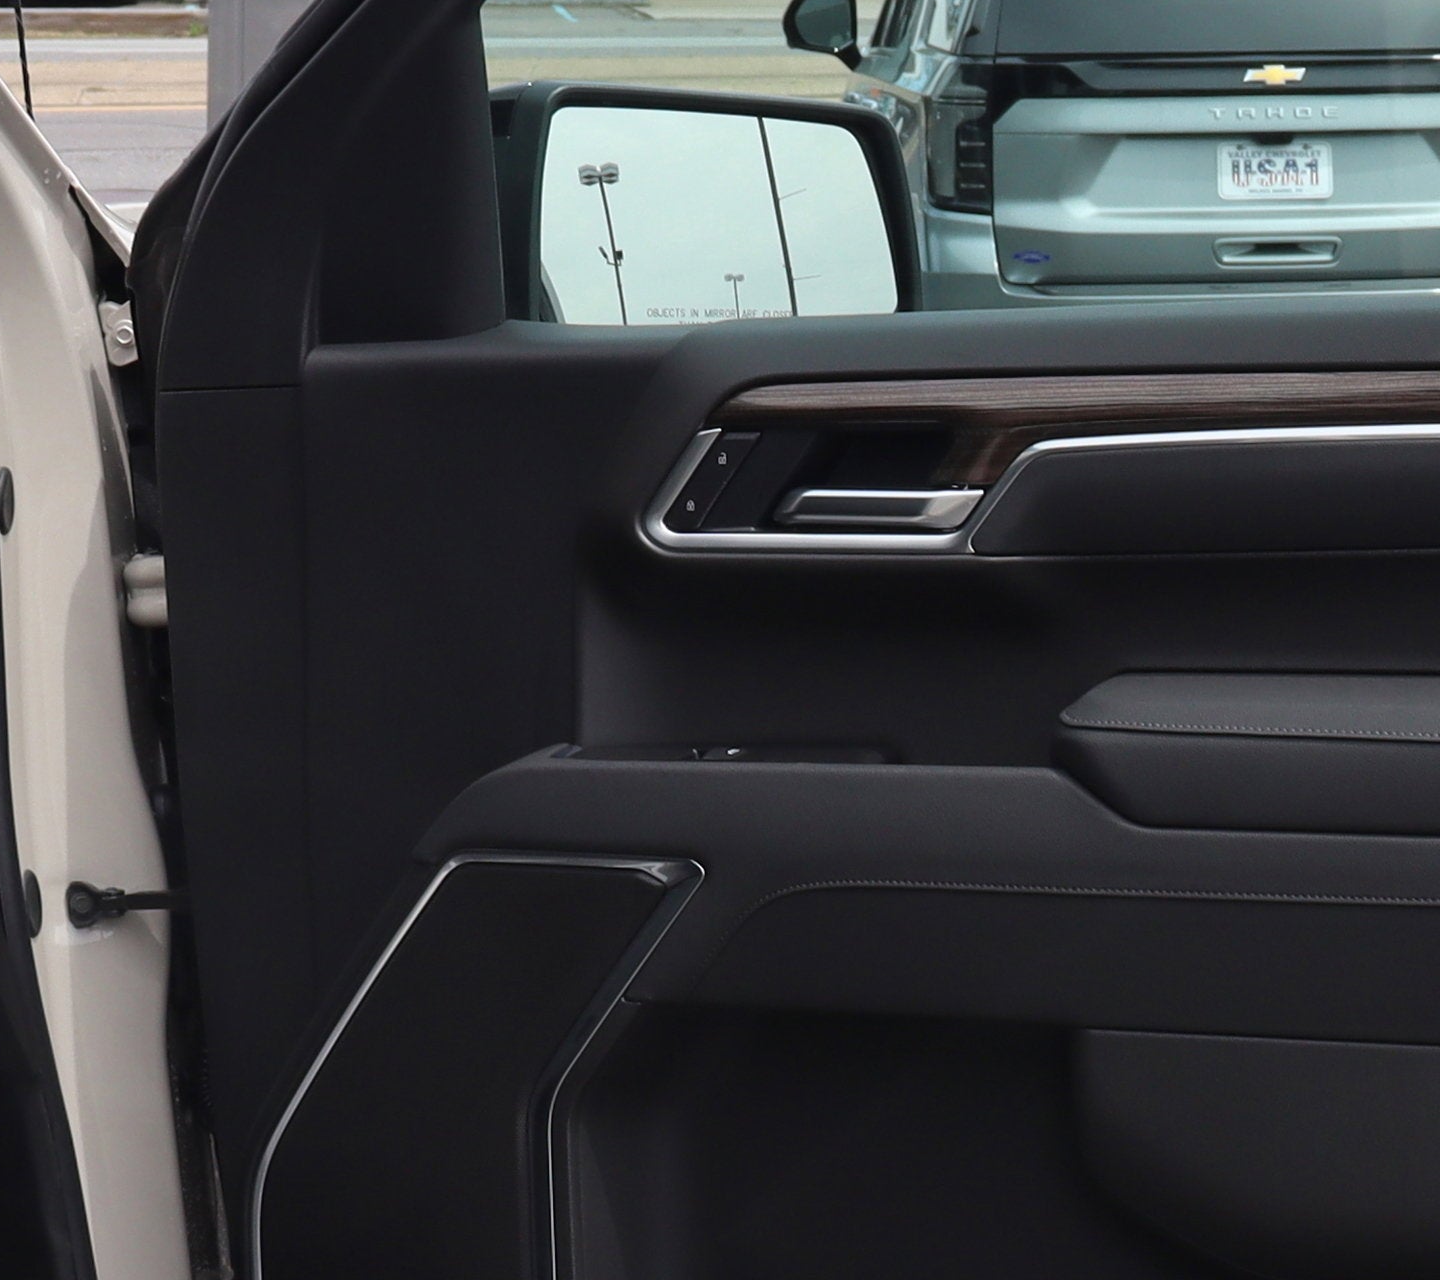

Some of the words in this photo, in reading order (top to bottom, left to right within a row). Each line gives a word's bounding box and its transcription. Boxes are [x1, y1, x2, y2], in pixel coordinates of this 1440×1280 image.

[1209, 105, 1339, 119] TAHOE
[646, 308, 686, 318] OBJECTS
[690, 308, 699, 318] IN
[704, 308, 737, 318] MIRROR
